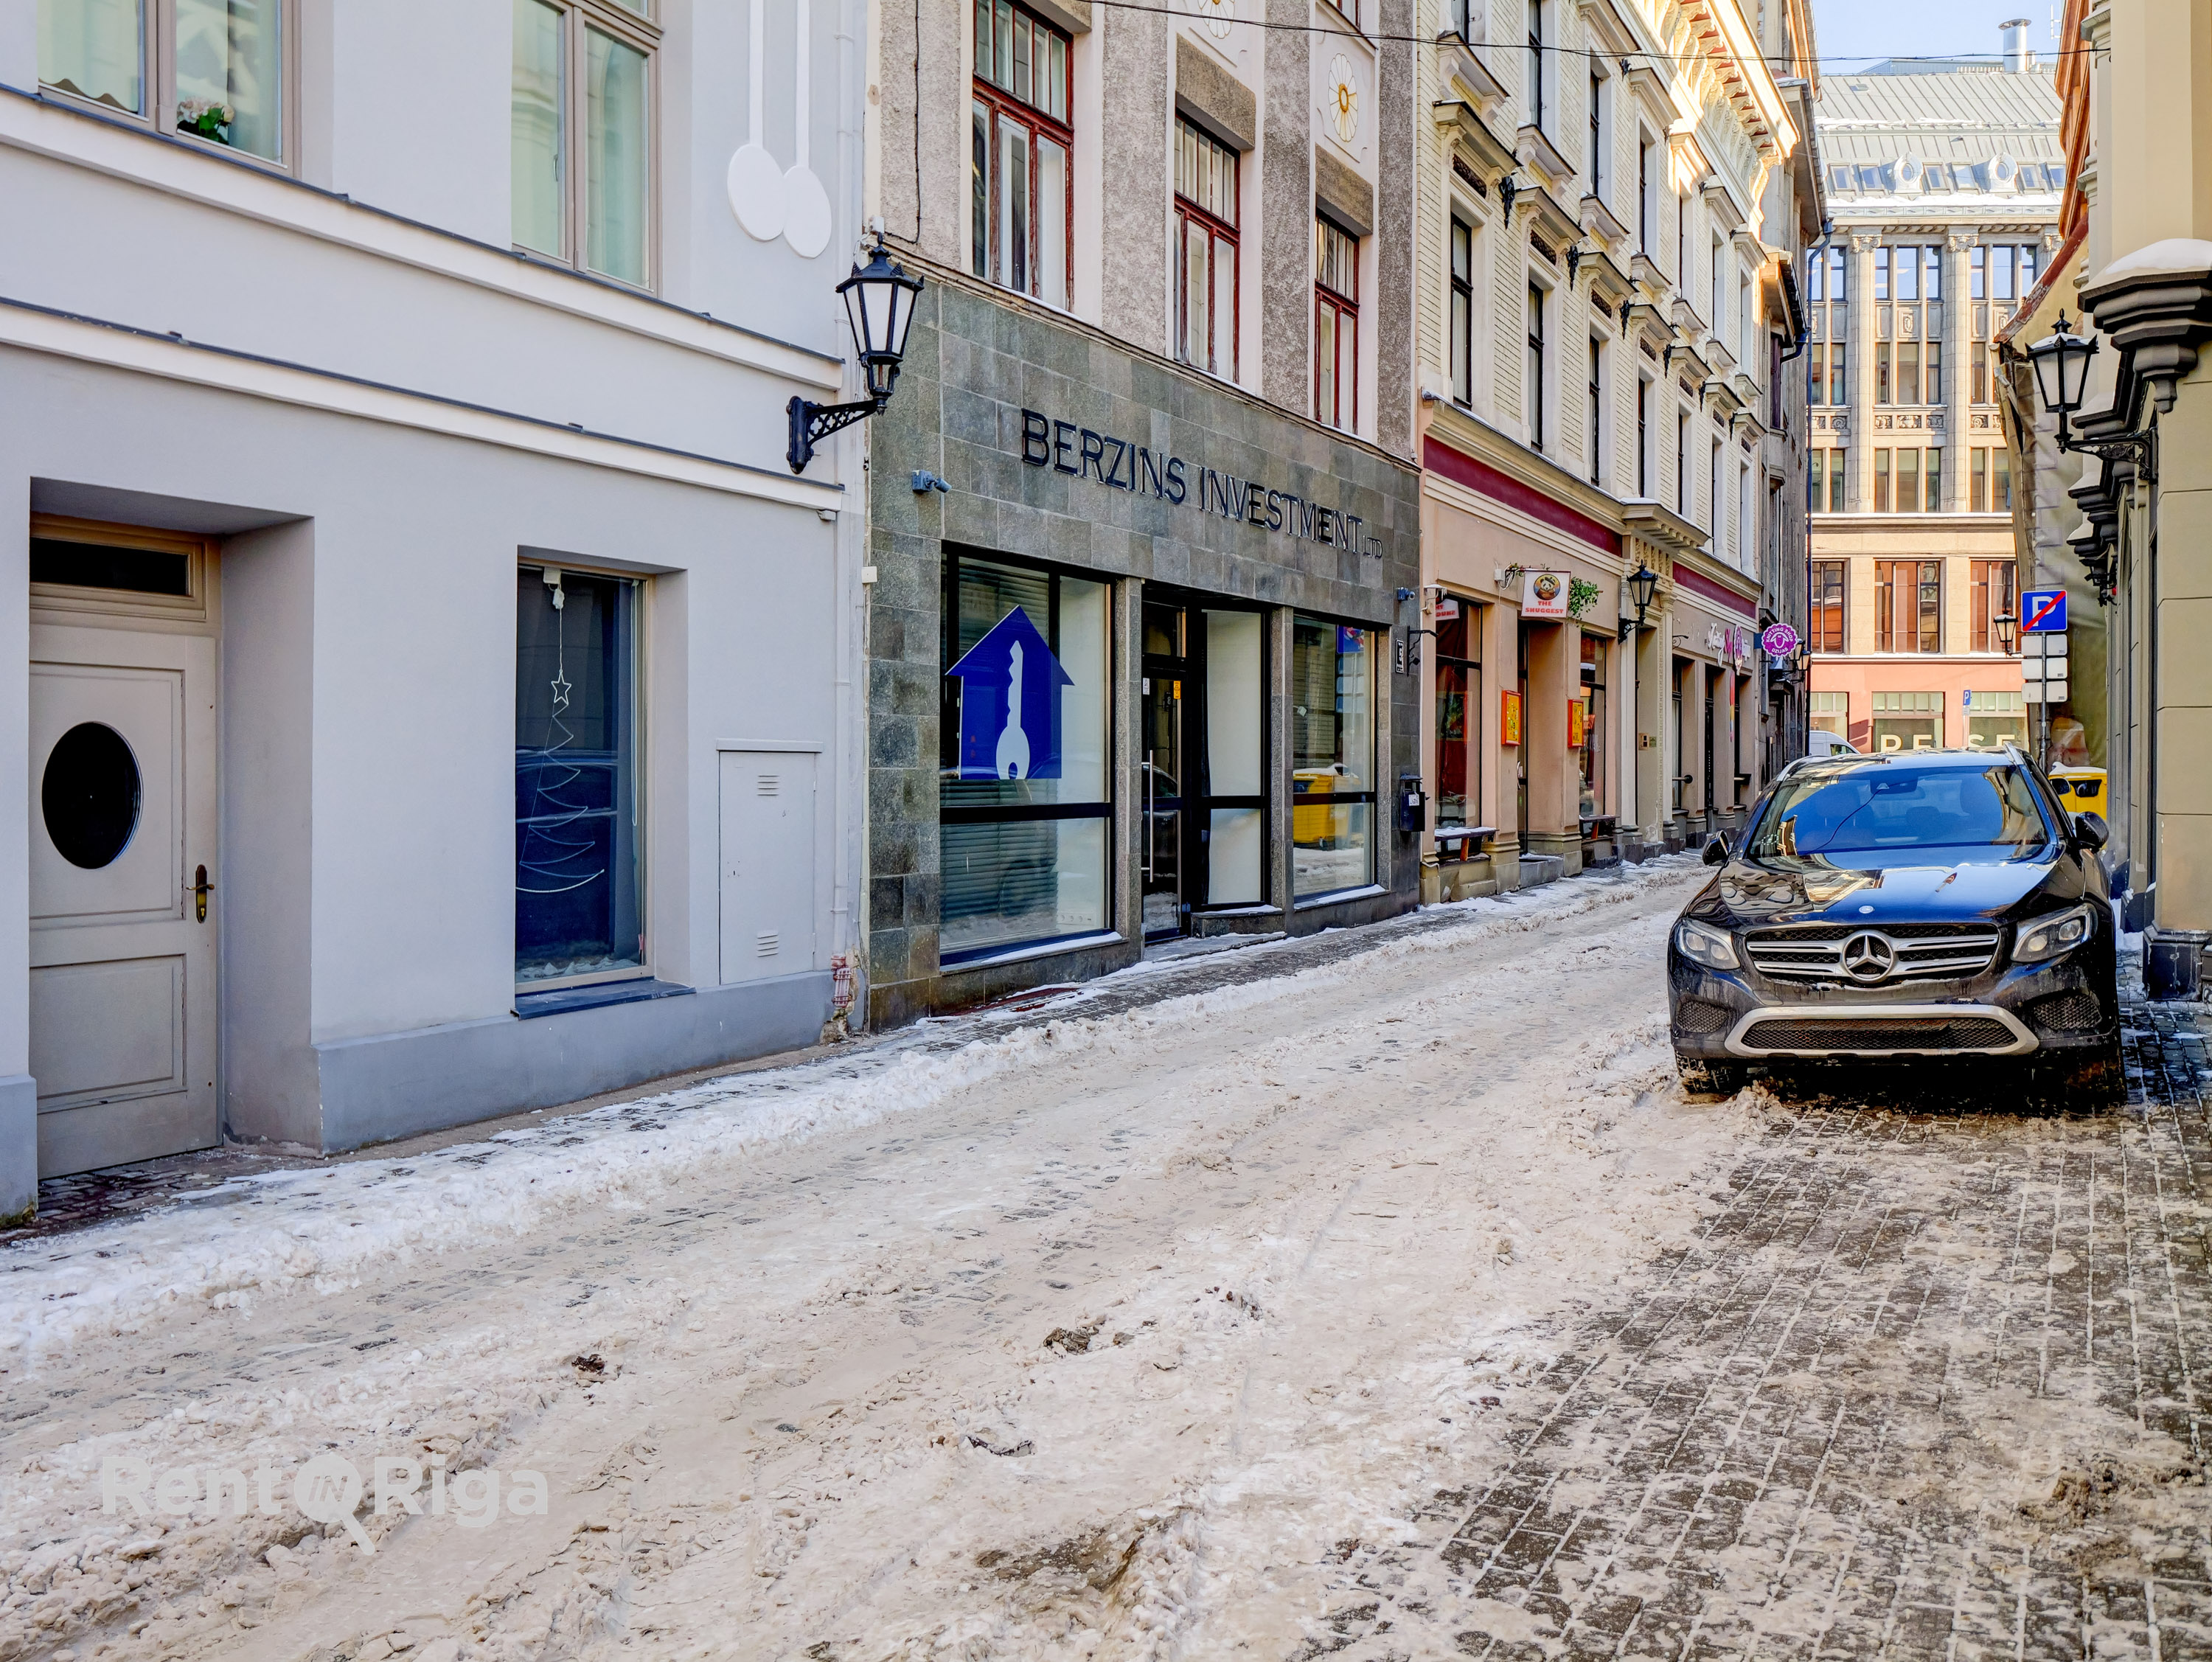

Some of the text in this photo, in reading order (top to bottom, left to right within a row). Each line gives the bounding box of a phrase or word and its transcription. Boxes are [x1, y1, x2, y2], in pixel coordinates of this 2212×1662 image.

[1021, 408, 1383, 559] BERZINS INVESTMENT LTD
[2032, 596, 2056, 627] P
[1766, 627, 1793, 642] KNITTING SHOP
[1964, 691, 1969, 704] P
